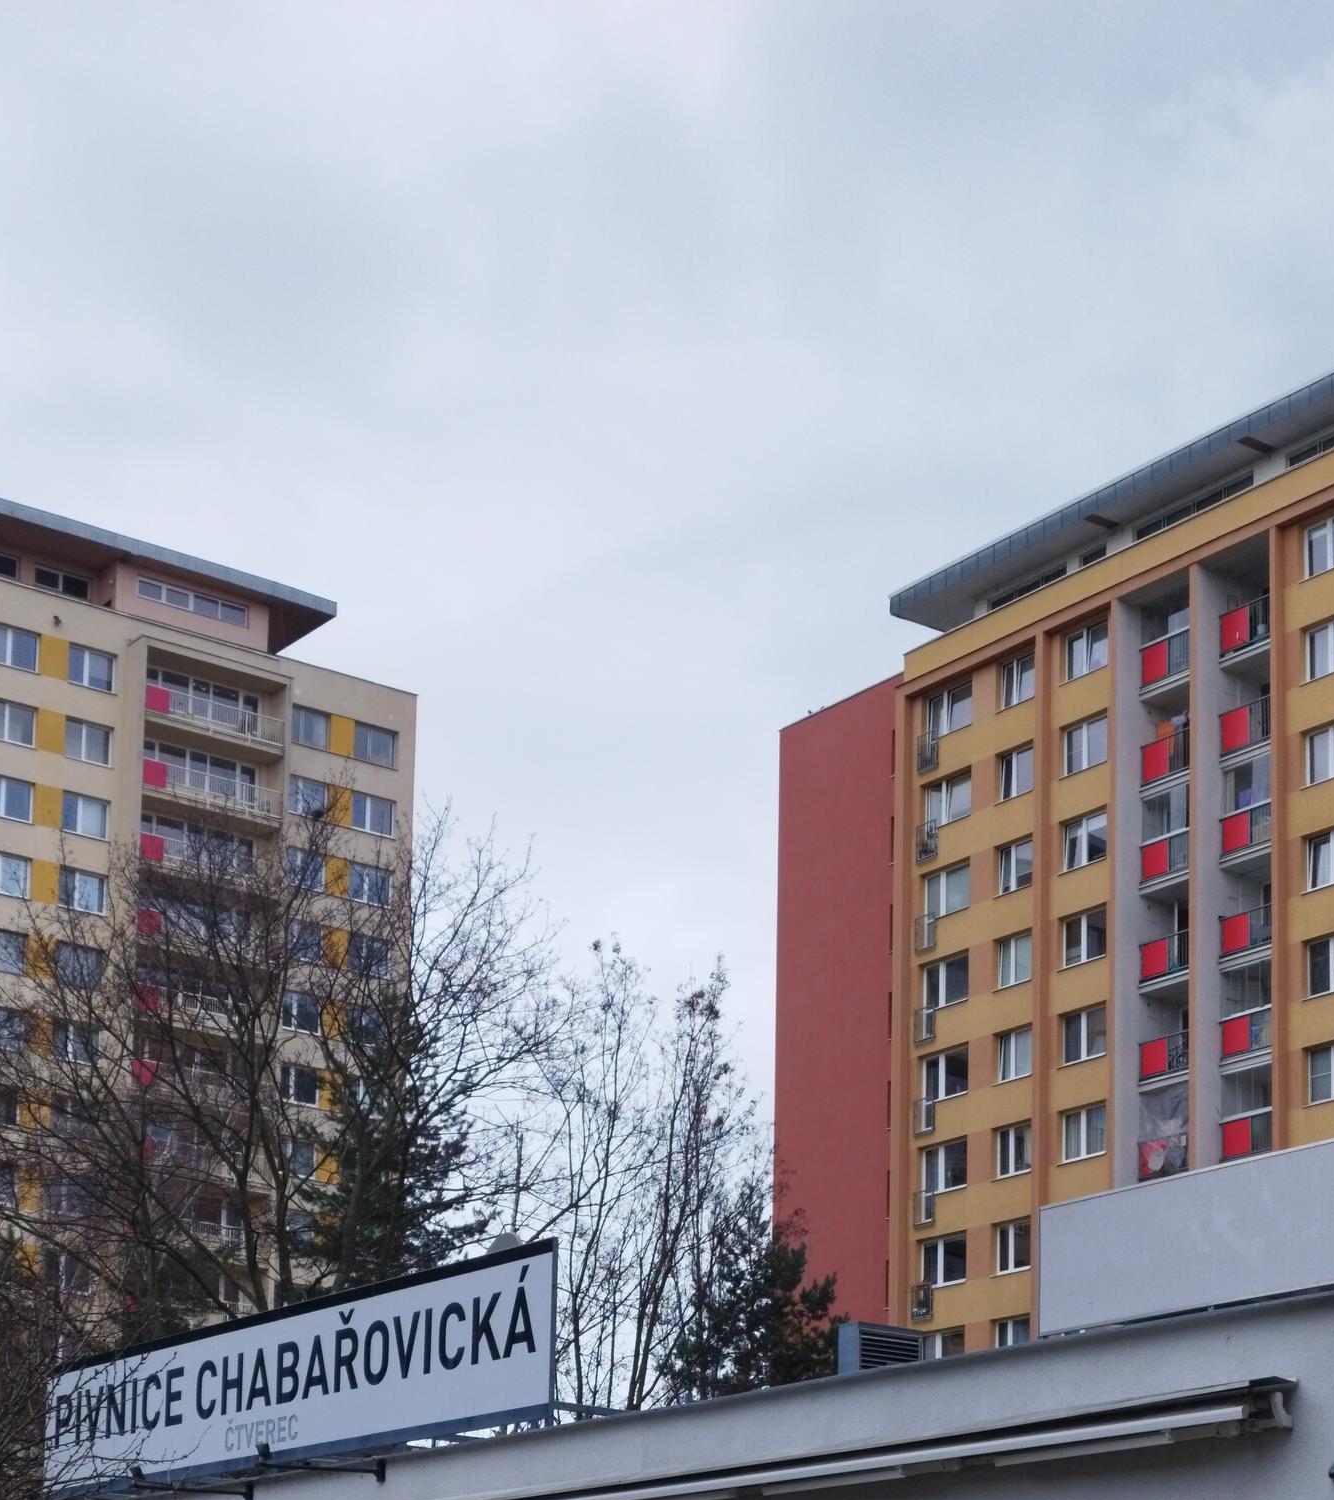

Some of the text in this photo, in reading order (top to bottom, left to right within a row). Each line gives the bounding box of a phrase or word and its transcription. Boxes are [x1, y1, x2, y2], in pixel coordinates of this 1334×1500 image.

[55, 1263, 537, 1450] PIVNICE CHABAŘOVICKÁ
[224, 1415, 299, 1452] ČTVEREC
